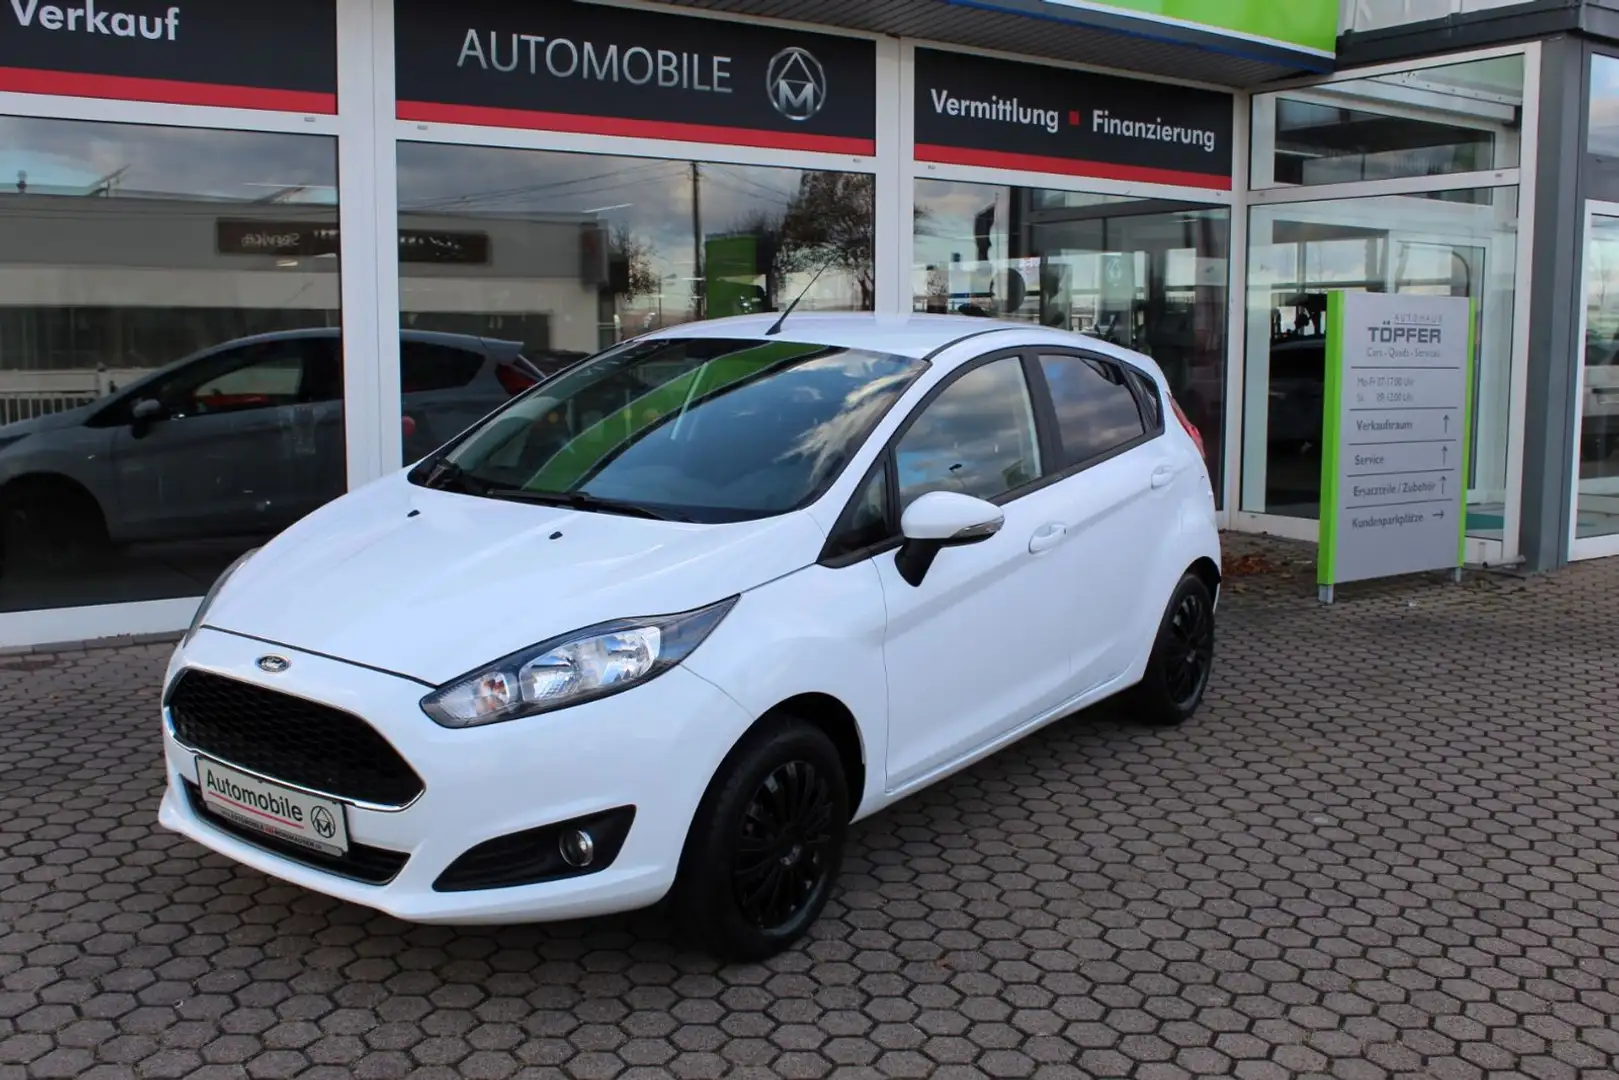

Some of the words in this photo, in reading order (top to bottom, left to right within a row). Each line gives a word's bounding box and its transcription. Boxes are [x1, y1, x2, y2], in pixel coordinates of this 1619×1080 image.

[10, 0, 180, 41] Verkauf
[457, 28, 733, 93] AUTOMOBILE
[931, 88, 1059, 133] Vermittlung
[1092, 109, 1215, 152] Finanzierung
[1367, 319, 1442, 344] TÖPFER
[1356, 419, 1414, 431] Verkaufsraum
[1354, 454, 1384, 466] Service
[1352, 514, 1424, 529] Kundenparkplätze
[207, 769, 304, 822] Automobile
